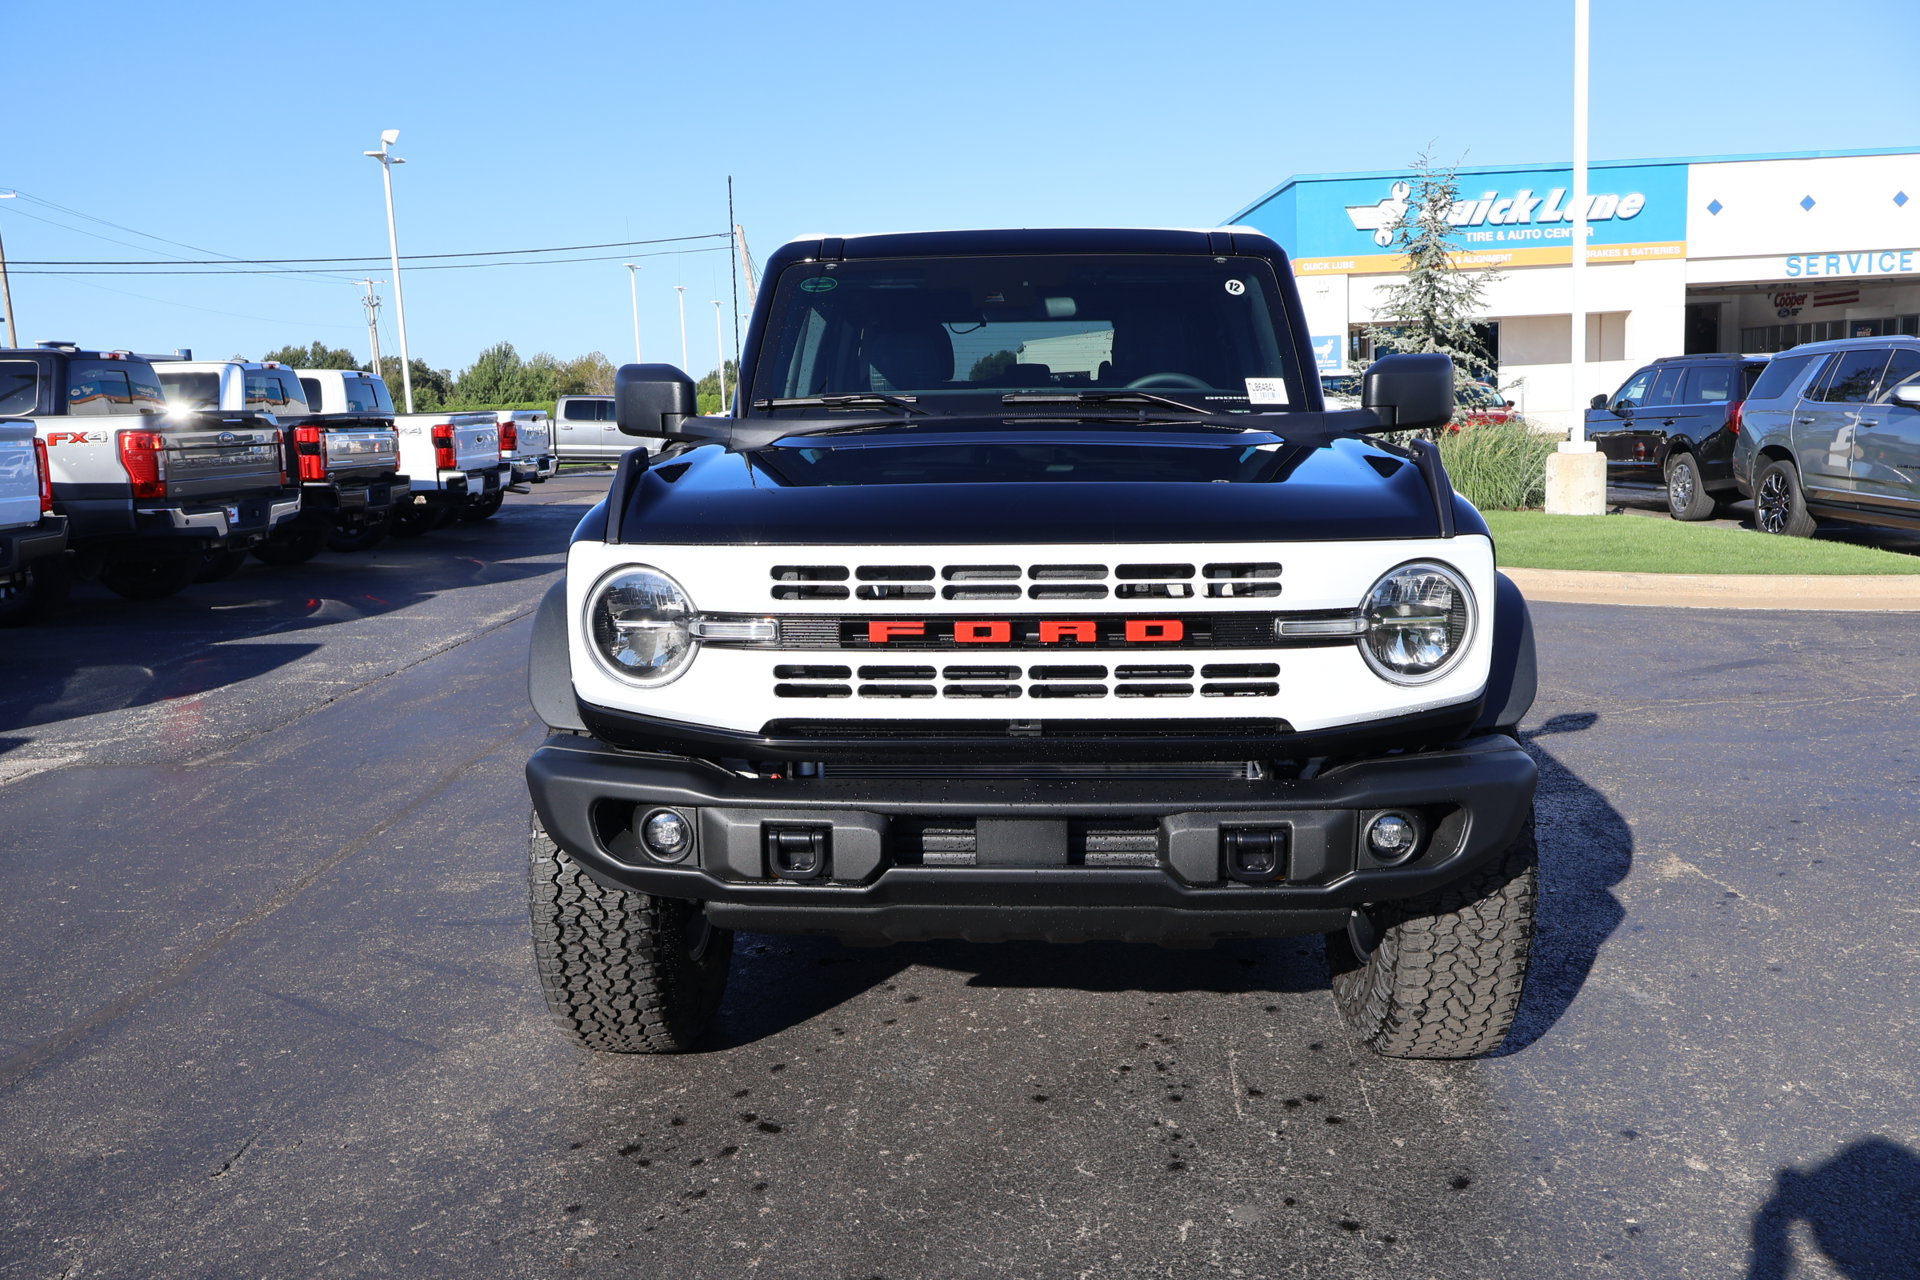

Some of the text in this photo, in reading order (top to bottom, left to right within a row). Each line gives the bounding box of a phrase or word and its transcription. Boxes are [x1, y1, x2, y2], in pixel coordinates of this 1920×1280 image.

[1467, 226, 1594, 242] TIRE & AUTO CENTR
[1464, 253, 1513, 264] ALIGNMENT
[1623, 248, 1630, 257] &
[1631, 246, 1681, 256] BATTERIES
[1303, 261, 1356, 271] QUICK LUBE
[1785, 250, 1914, 277] SERVICE
[1229, 281, 1241, 293] 12
[1774, 291, 1808, 308] Cooper
[47, 431, 108, 446] FX4
[868, 620, 1183, 643] FORD
